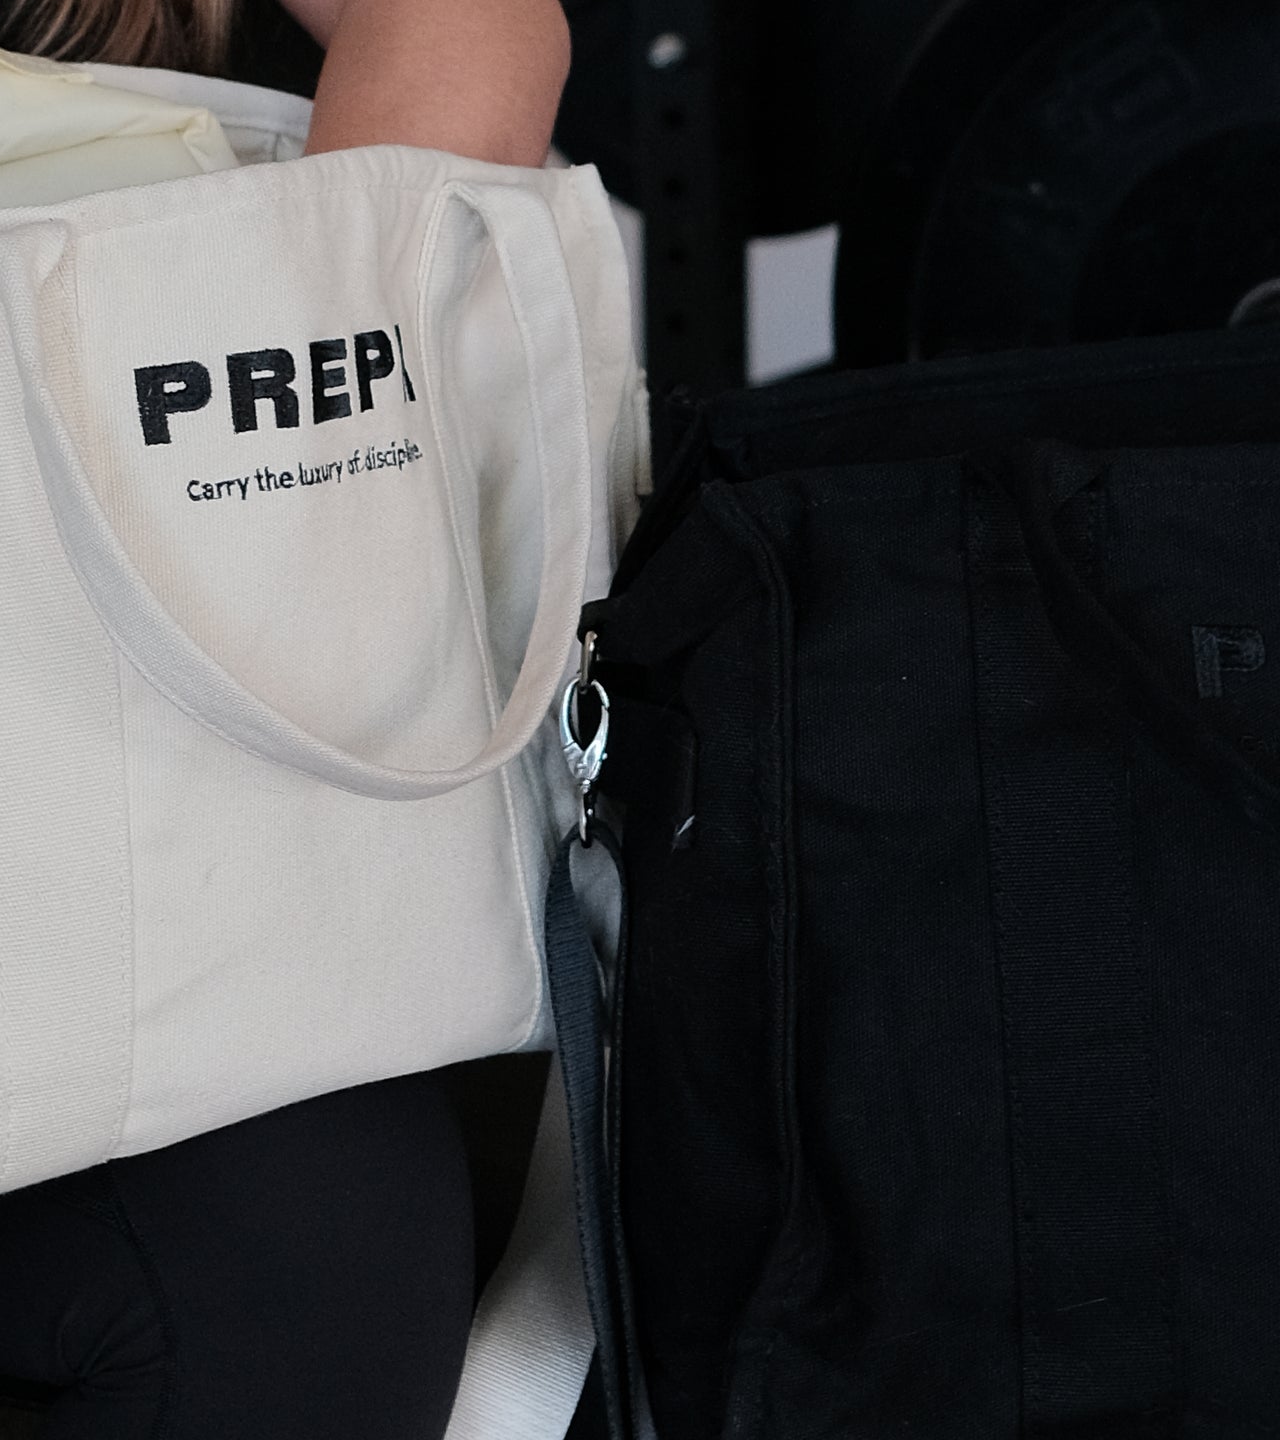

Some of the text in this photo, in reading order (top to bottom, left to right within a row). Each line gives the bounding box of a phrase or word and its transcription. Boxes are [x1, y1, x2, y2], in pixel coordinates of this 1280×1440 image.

[186, 476, 250, 502] Carry
[254, 465, 295, 492] the
[298, 461, 343, 487] luxury
[347, 448, 362, 475] of
